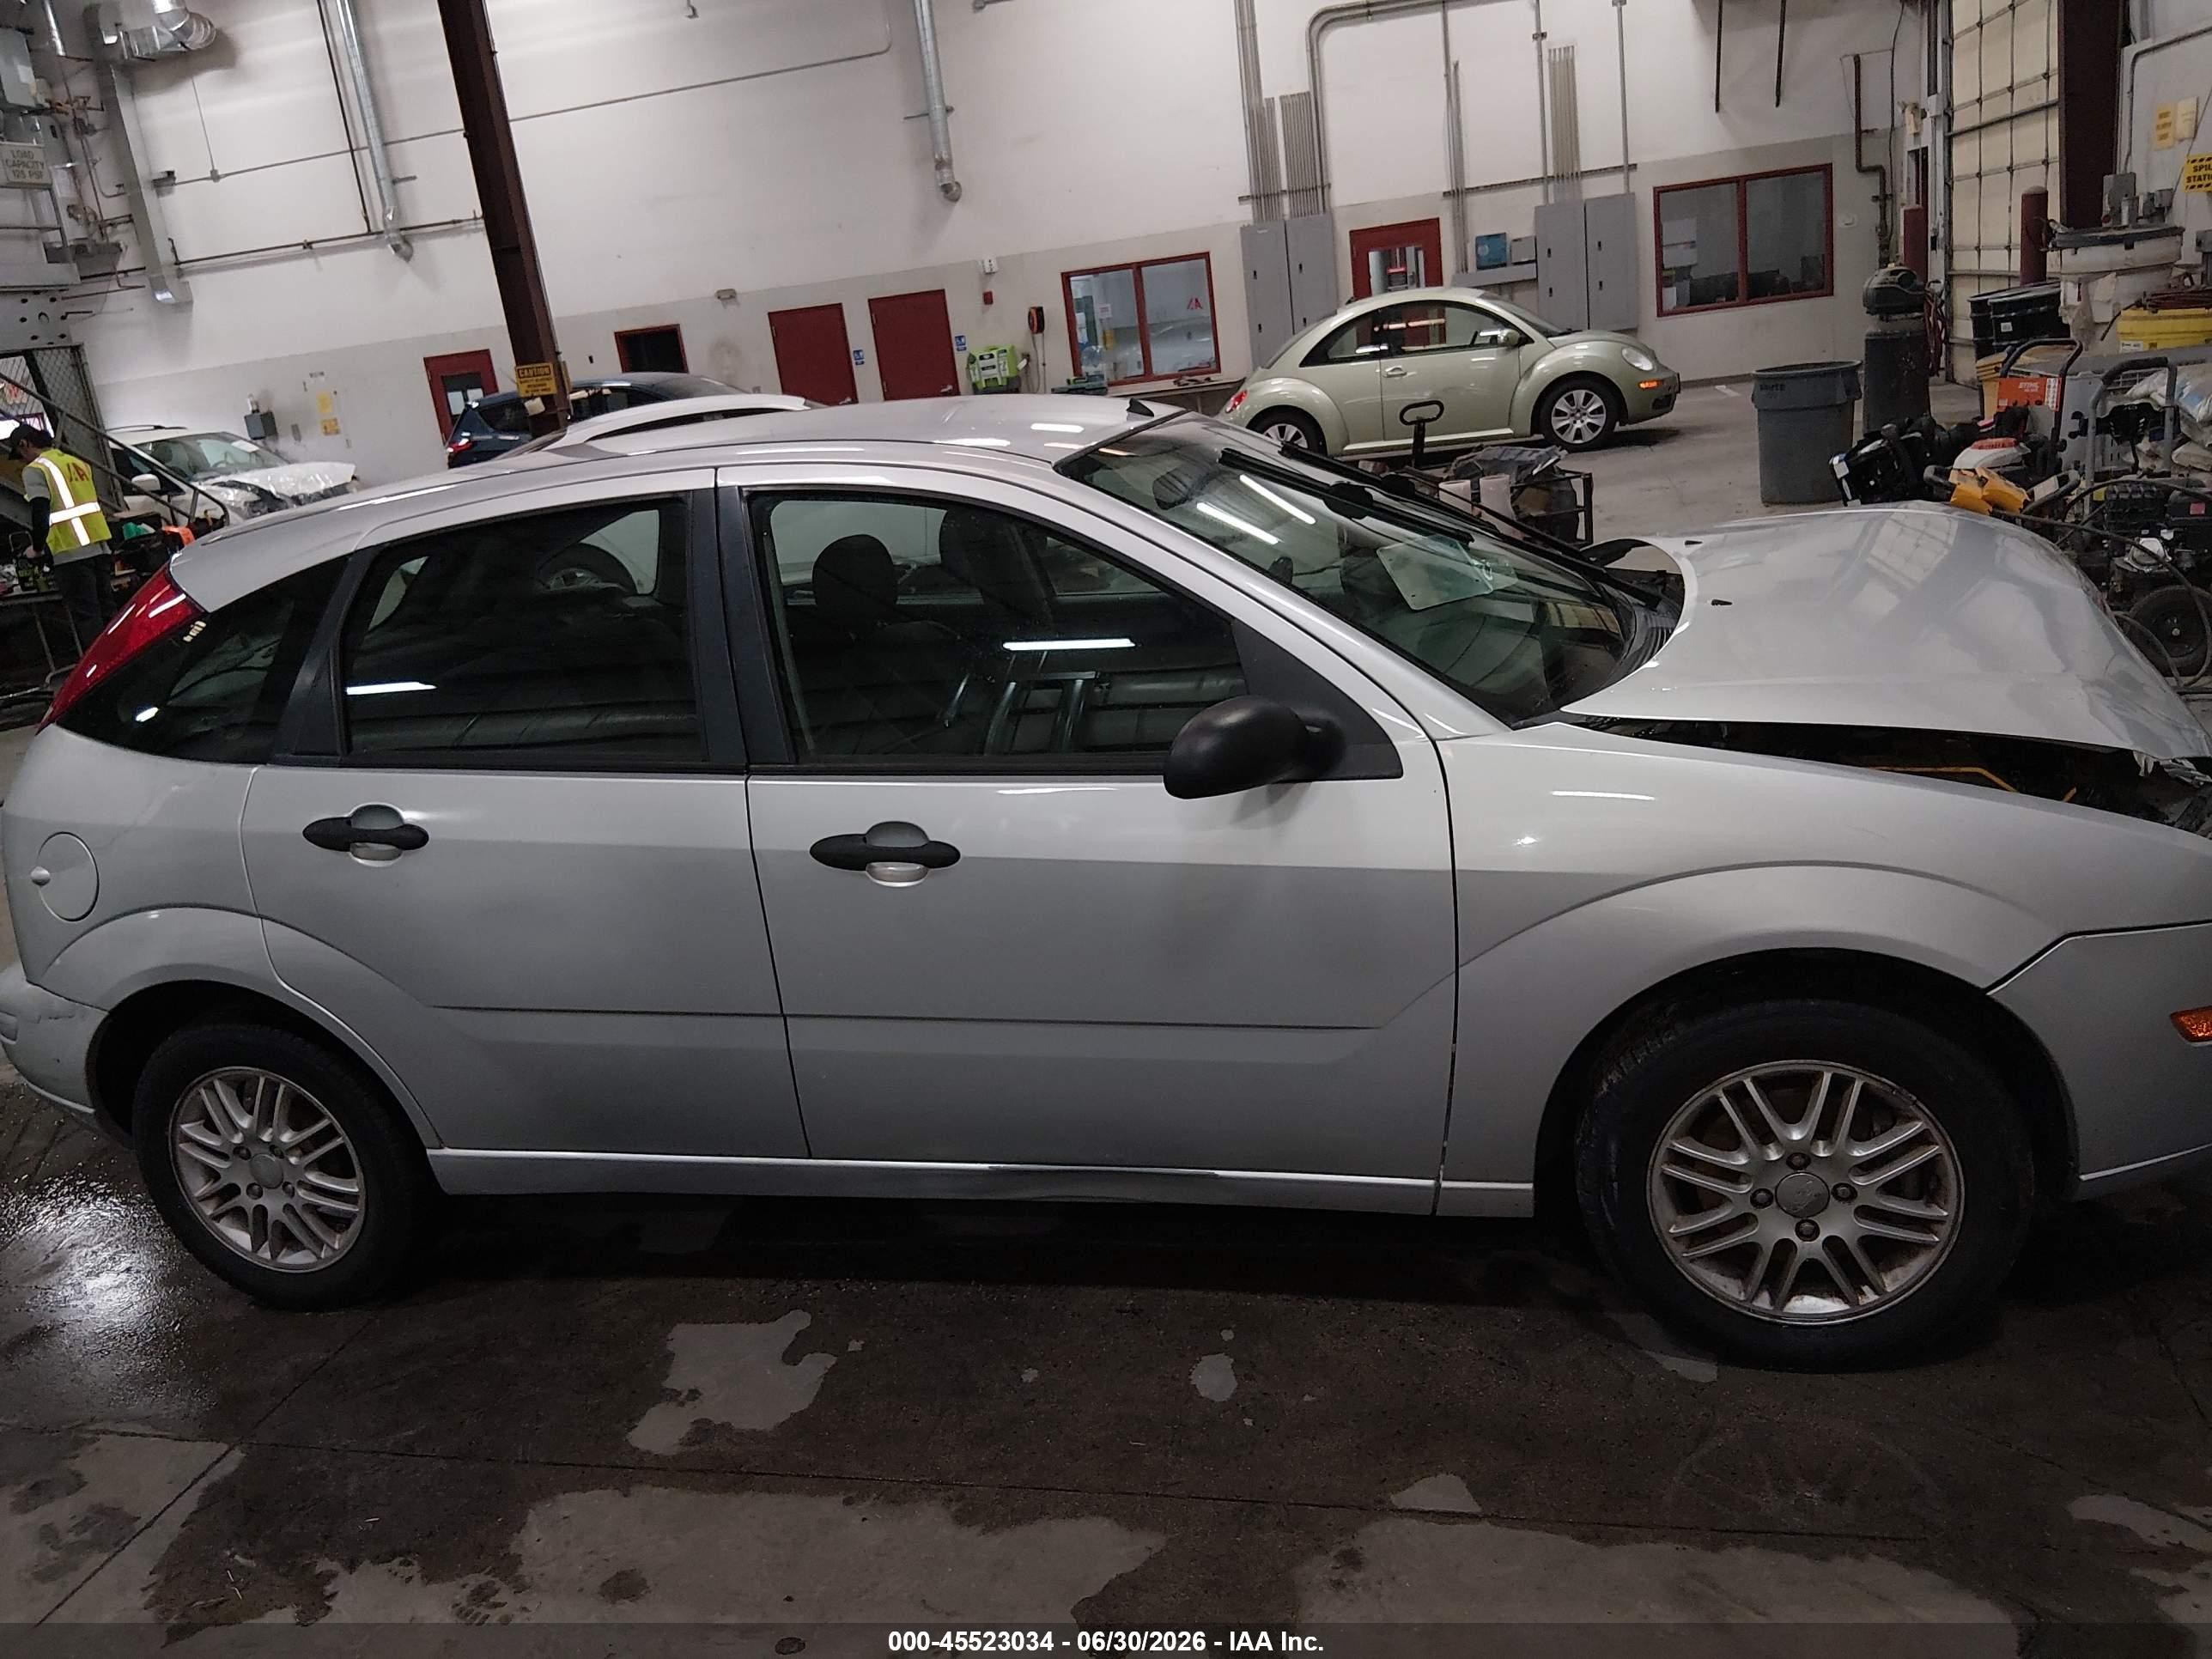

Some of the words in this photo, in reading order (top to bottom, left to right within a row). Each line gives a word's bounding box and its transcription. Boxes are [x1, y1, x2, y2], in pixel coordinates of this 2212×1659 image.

[10, 149, 34, 159] LOAD
[5, 159, 45, 169] CAPACITY
[2186, 174, 2212, 183] STATI
[519, 367, 550, 378] CAUTION
